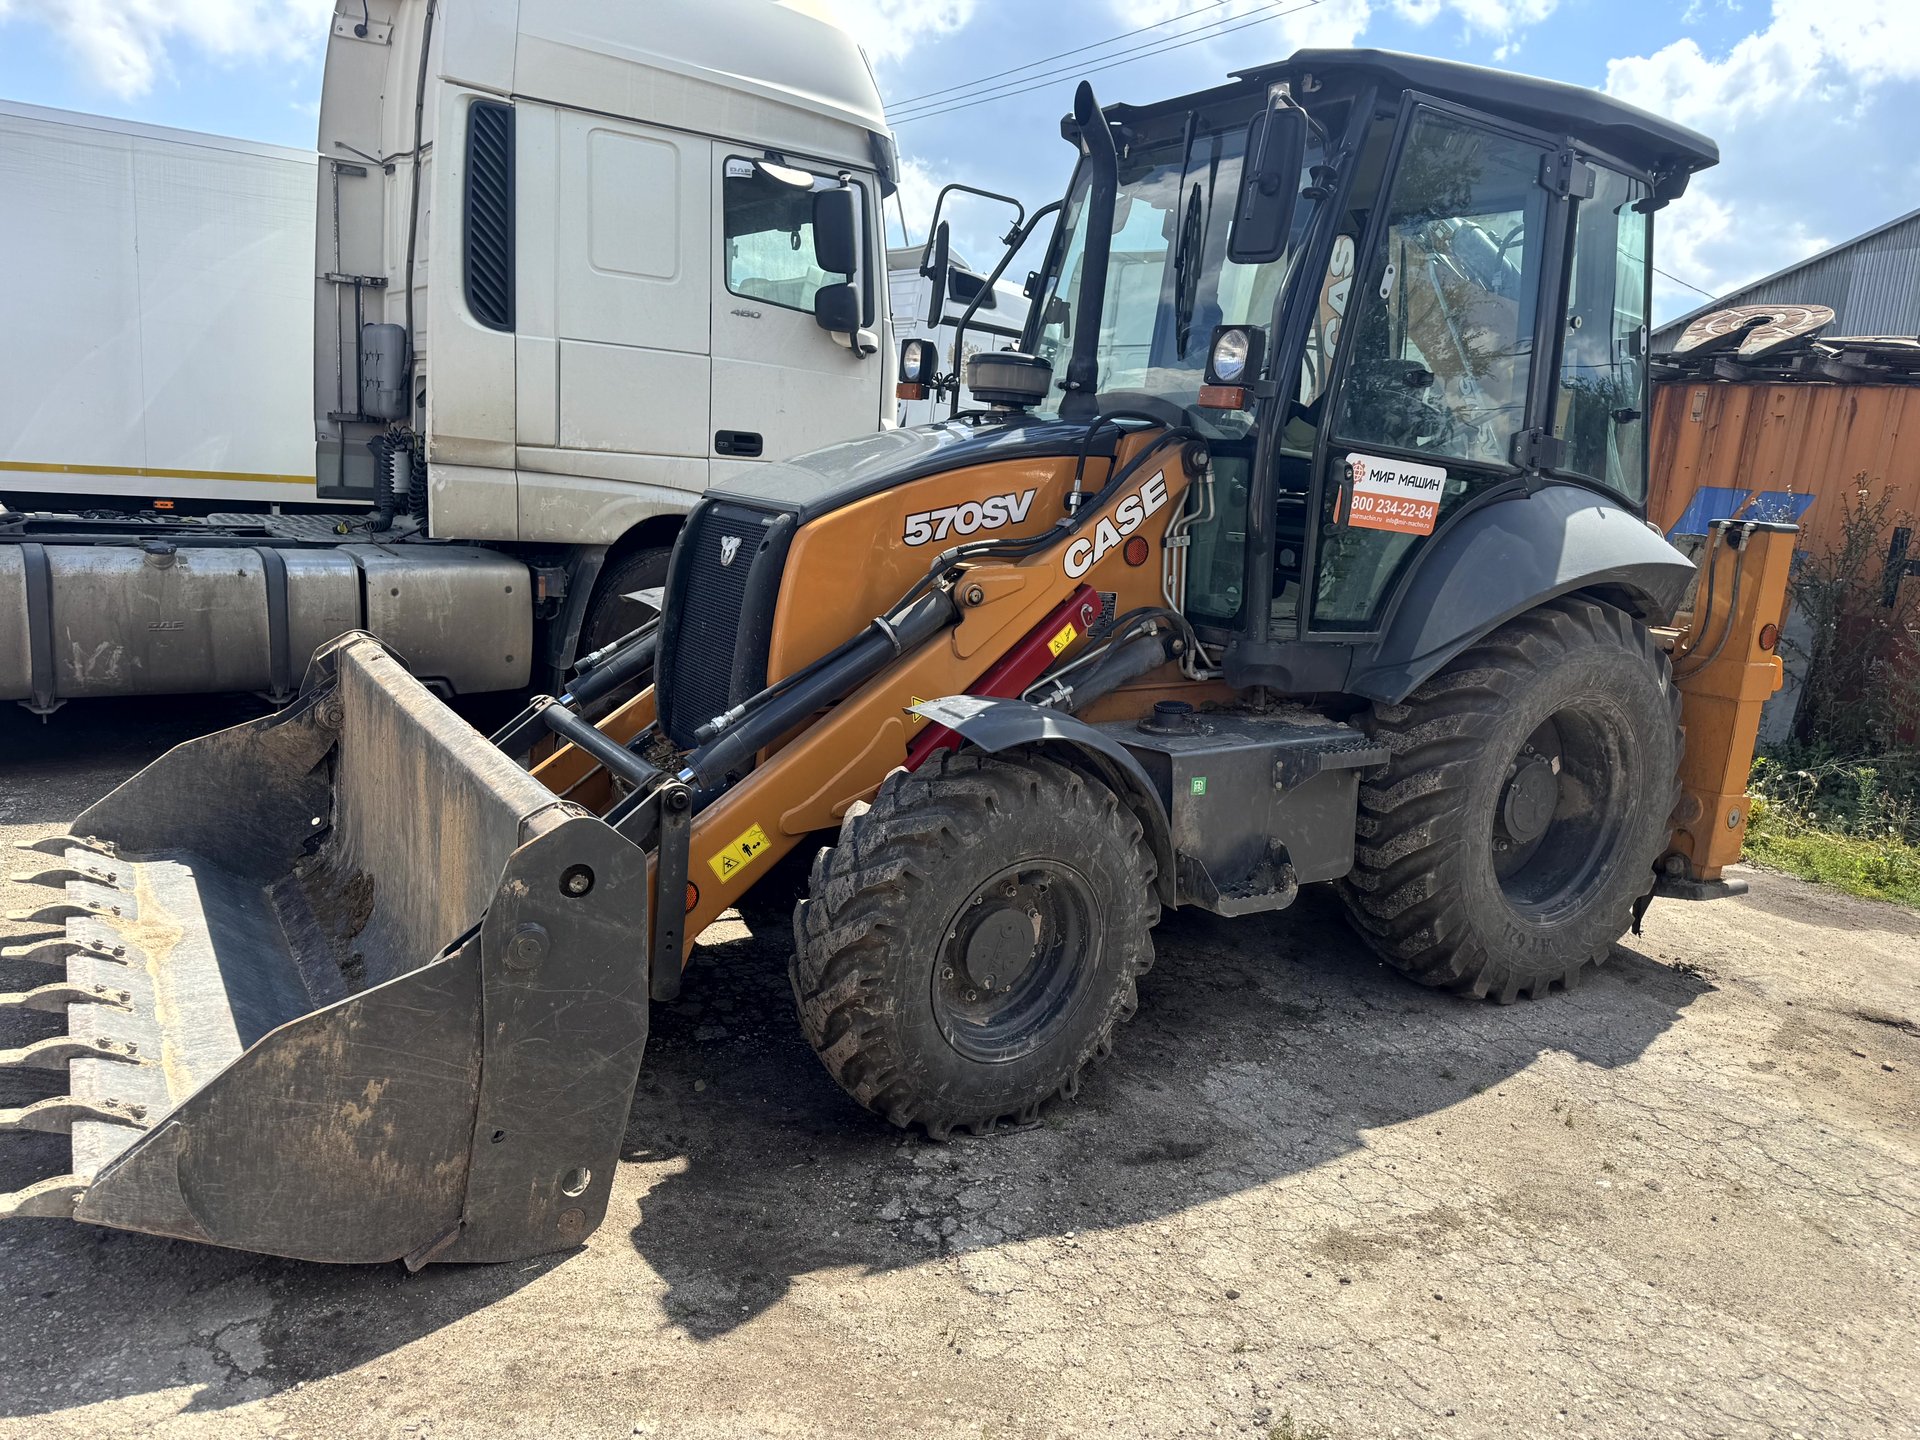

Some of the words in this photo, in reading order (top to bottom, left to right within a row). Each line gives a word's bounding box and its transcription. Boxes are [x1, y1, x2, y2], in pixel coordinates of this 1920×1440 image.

[730, 309, 761, 319] 460
[1323, 235, 1355, 359] CAS
[1369, 469, 1396, 484] МИР
[1398, 474, 1441, 491] МАШИН
[902, 488, 1038, 547] 570SV
[1063, 468, 1168, 579] CASE
[1351, 495, 1374, 512] 800
[1376, 498, 1433, 520] 234-22-84
